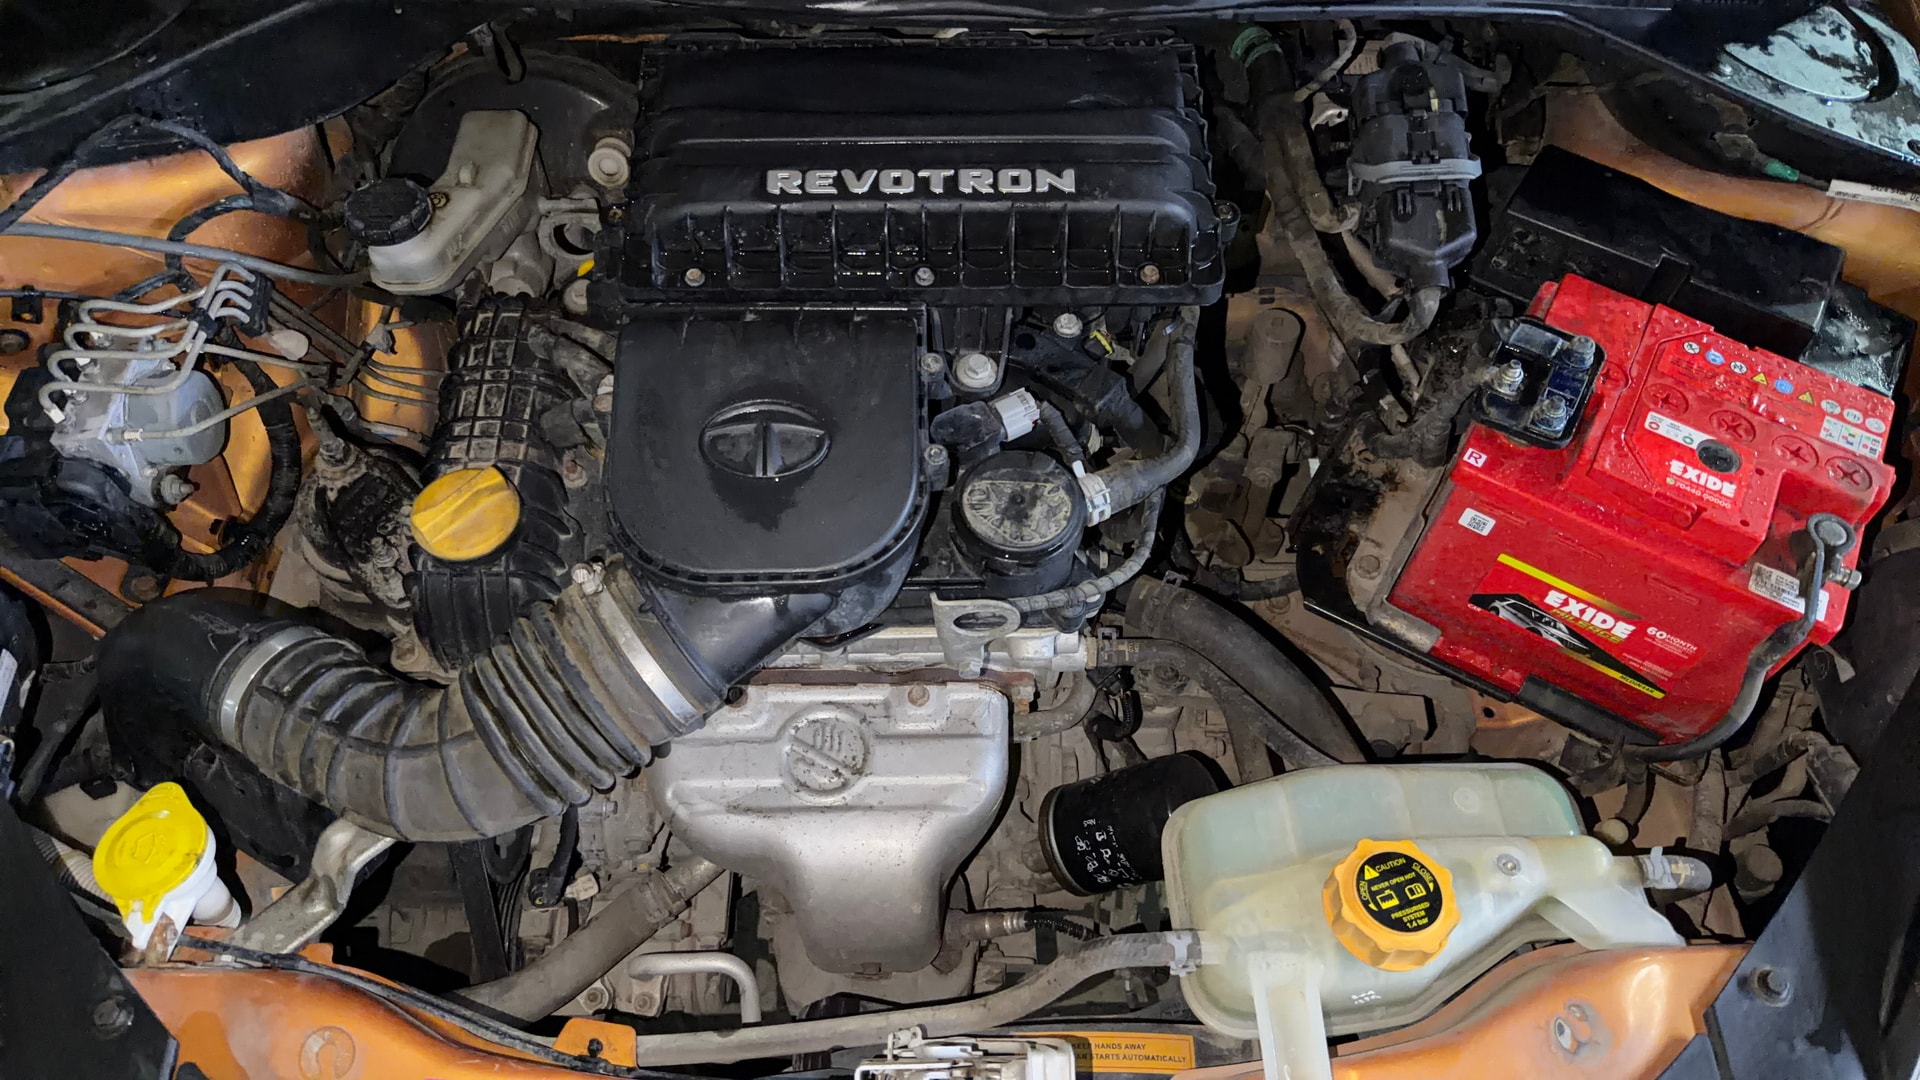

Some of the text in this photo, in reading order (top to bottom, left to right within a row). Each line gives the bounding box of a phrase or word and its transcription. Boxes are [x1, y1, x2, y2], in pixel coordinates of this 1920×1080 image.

[766, 168, 1076, 195] REVOTRON
[1467, 450, 1482, 465] R
[1670, 459, 1737, 498] EXIDE
[1543, 589, 1637, 639] EXIDE
[1646, 626, 1667, 640] 60
[1665, 635, 1698, 652] MONTH
[1375, 857, 1406, 872] CAUTION
[1412, 862, 1434, 883] CLOSE
[1371, 871, 1416, 891] NEVER OPEN HOT
[1359, 881, 1368, 900] OPEN
[1390, 901, 1430, 919] PRESSURISED
[1402, 910, 1426, 922] SYSTEM
[1406, 917, 1429, 929] 1.4 bar
[1124, 1043, 1146, 1051] AWAY
[1091, 1053, 1121, 1061] STARTS
[1122, 1053, 1187, 1063] AUTOMATICALLY
